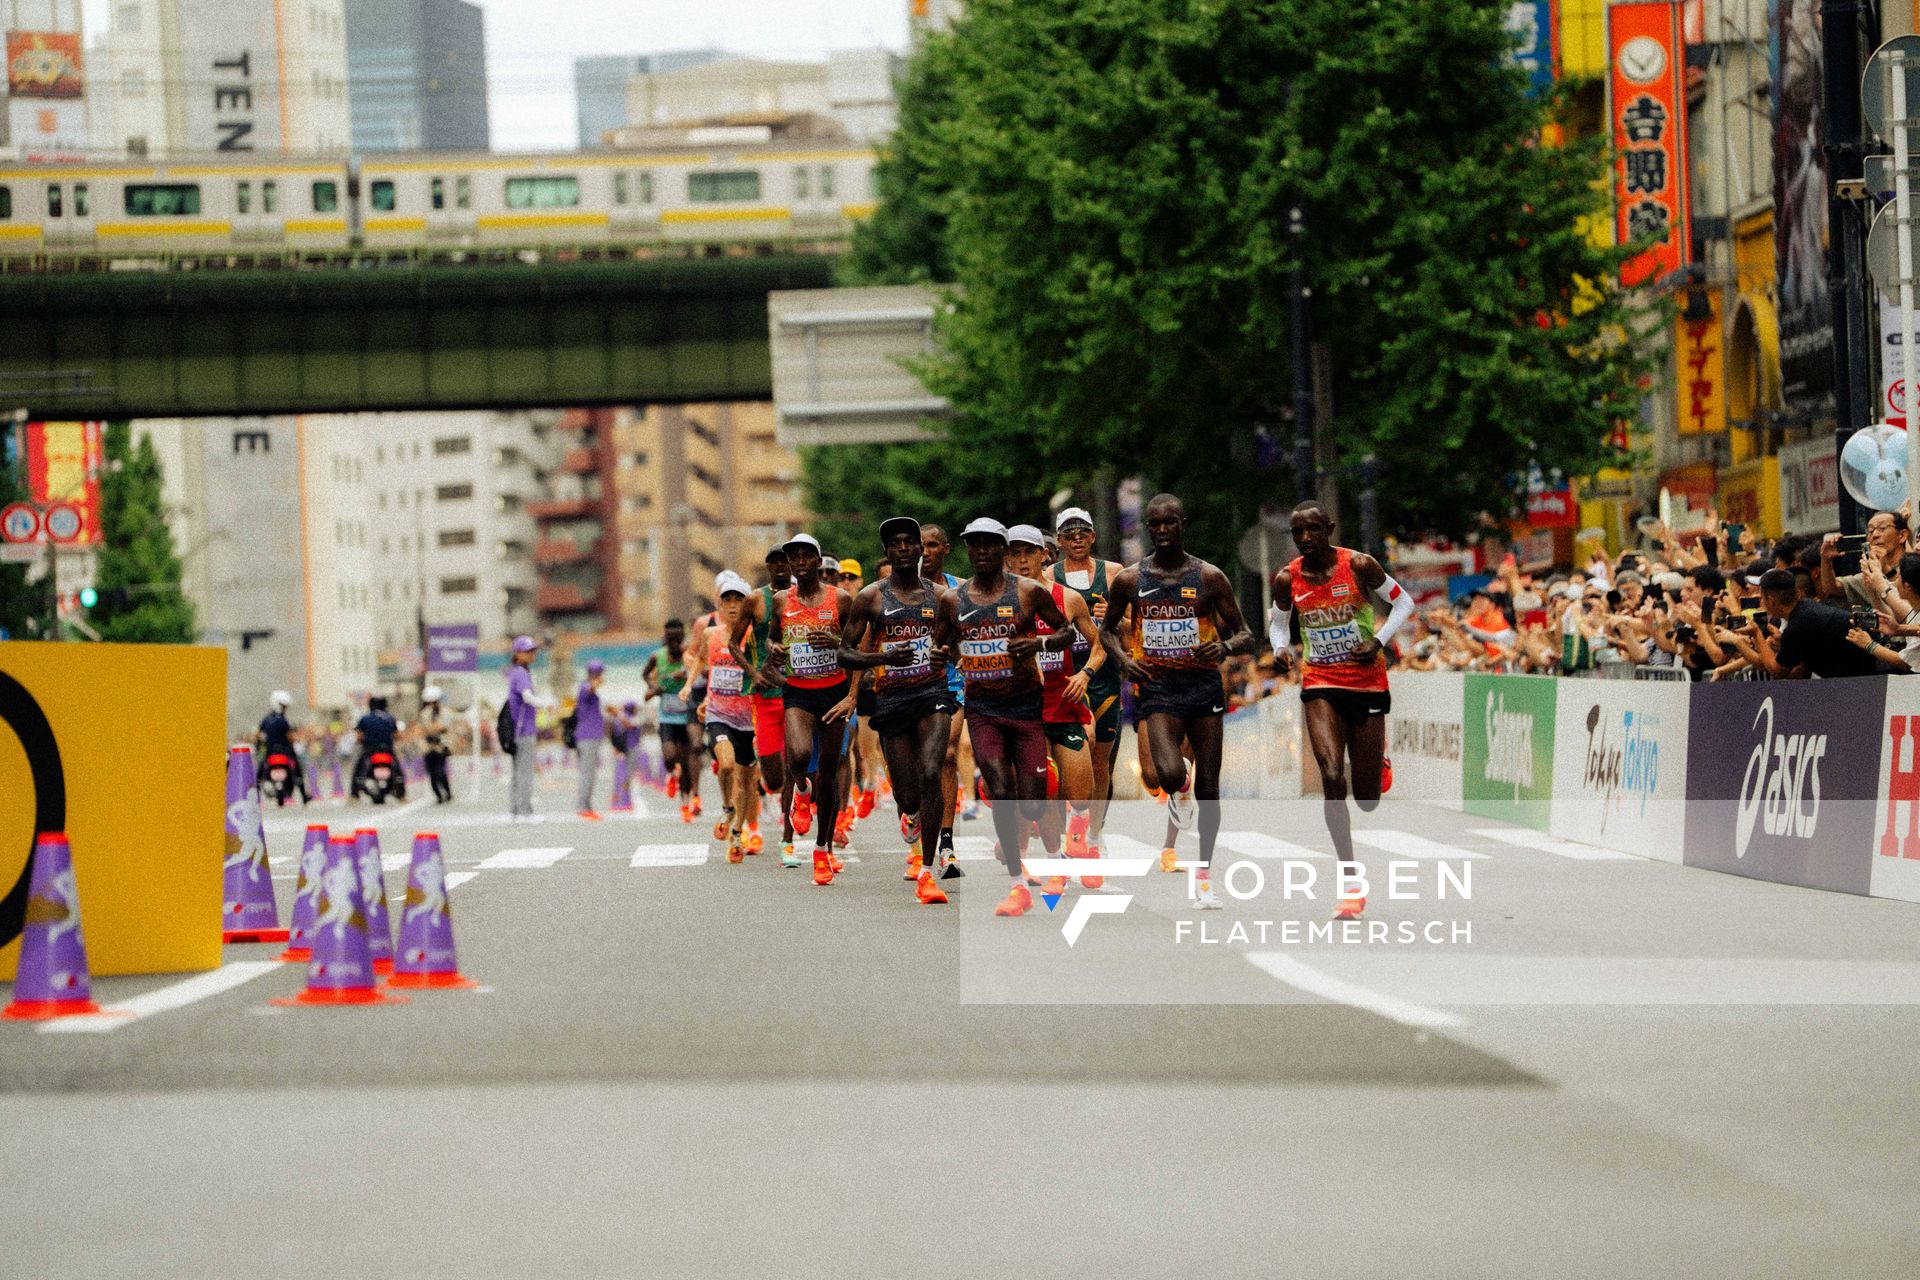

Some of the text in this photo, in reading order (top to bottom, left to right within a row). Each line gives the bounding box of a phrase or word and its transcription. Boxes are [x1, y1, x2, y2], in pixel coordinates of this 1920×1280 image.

[1140, 605, 1196, 618] UGANDA
[885, 625, 935, 637] UGANDA
[961, 623, 1017, 640] UGANDA
[1157, 620, 1194, 632] TDK
[1317, 624, 1354, 641] TDK
[1145, 632, 1198, 648] CHELANGAT
[1311, 635, 1360, 656] NGETICH
[969, 641, 1005, 655] TDK
[792, 653, 835, 667] KIPKOECH
[1039, 652, 1061, 661] RABY
[1393, 720, 1461, 762] JAPAN AIRLINES
[1584, 704, 1658, 836] Tokyo Tokyo
